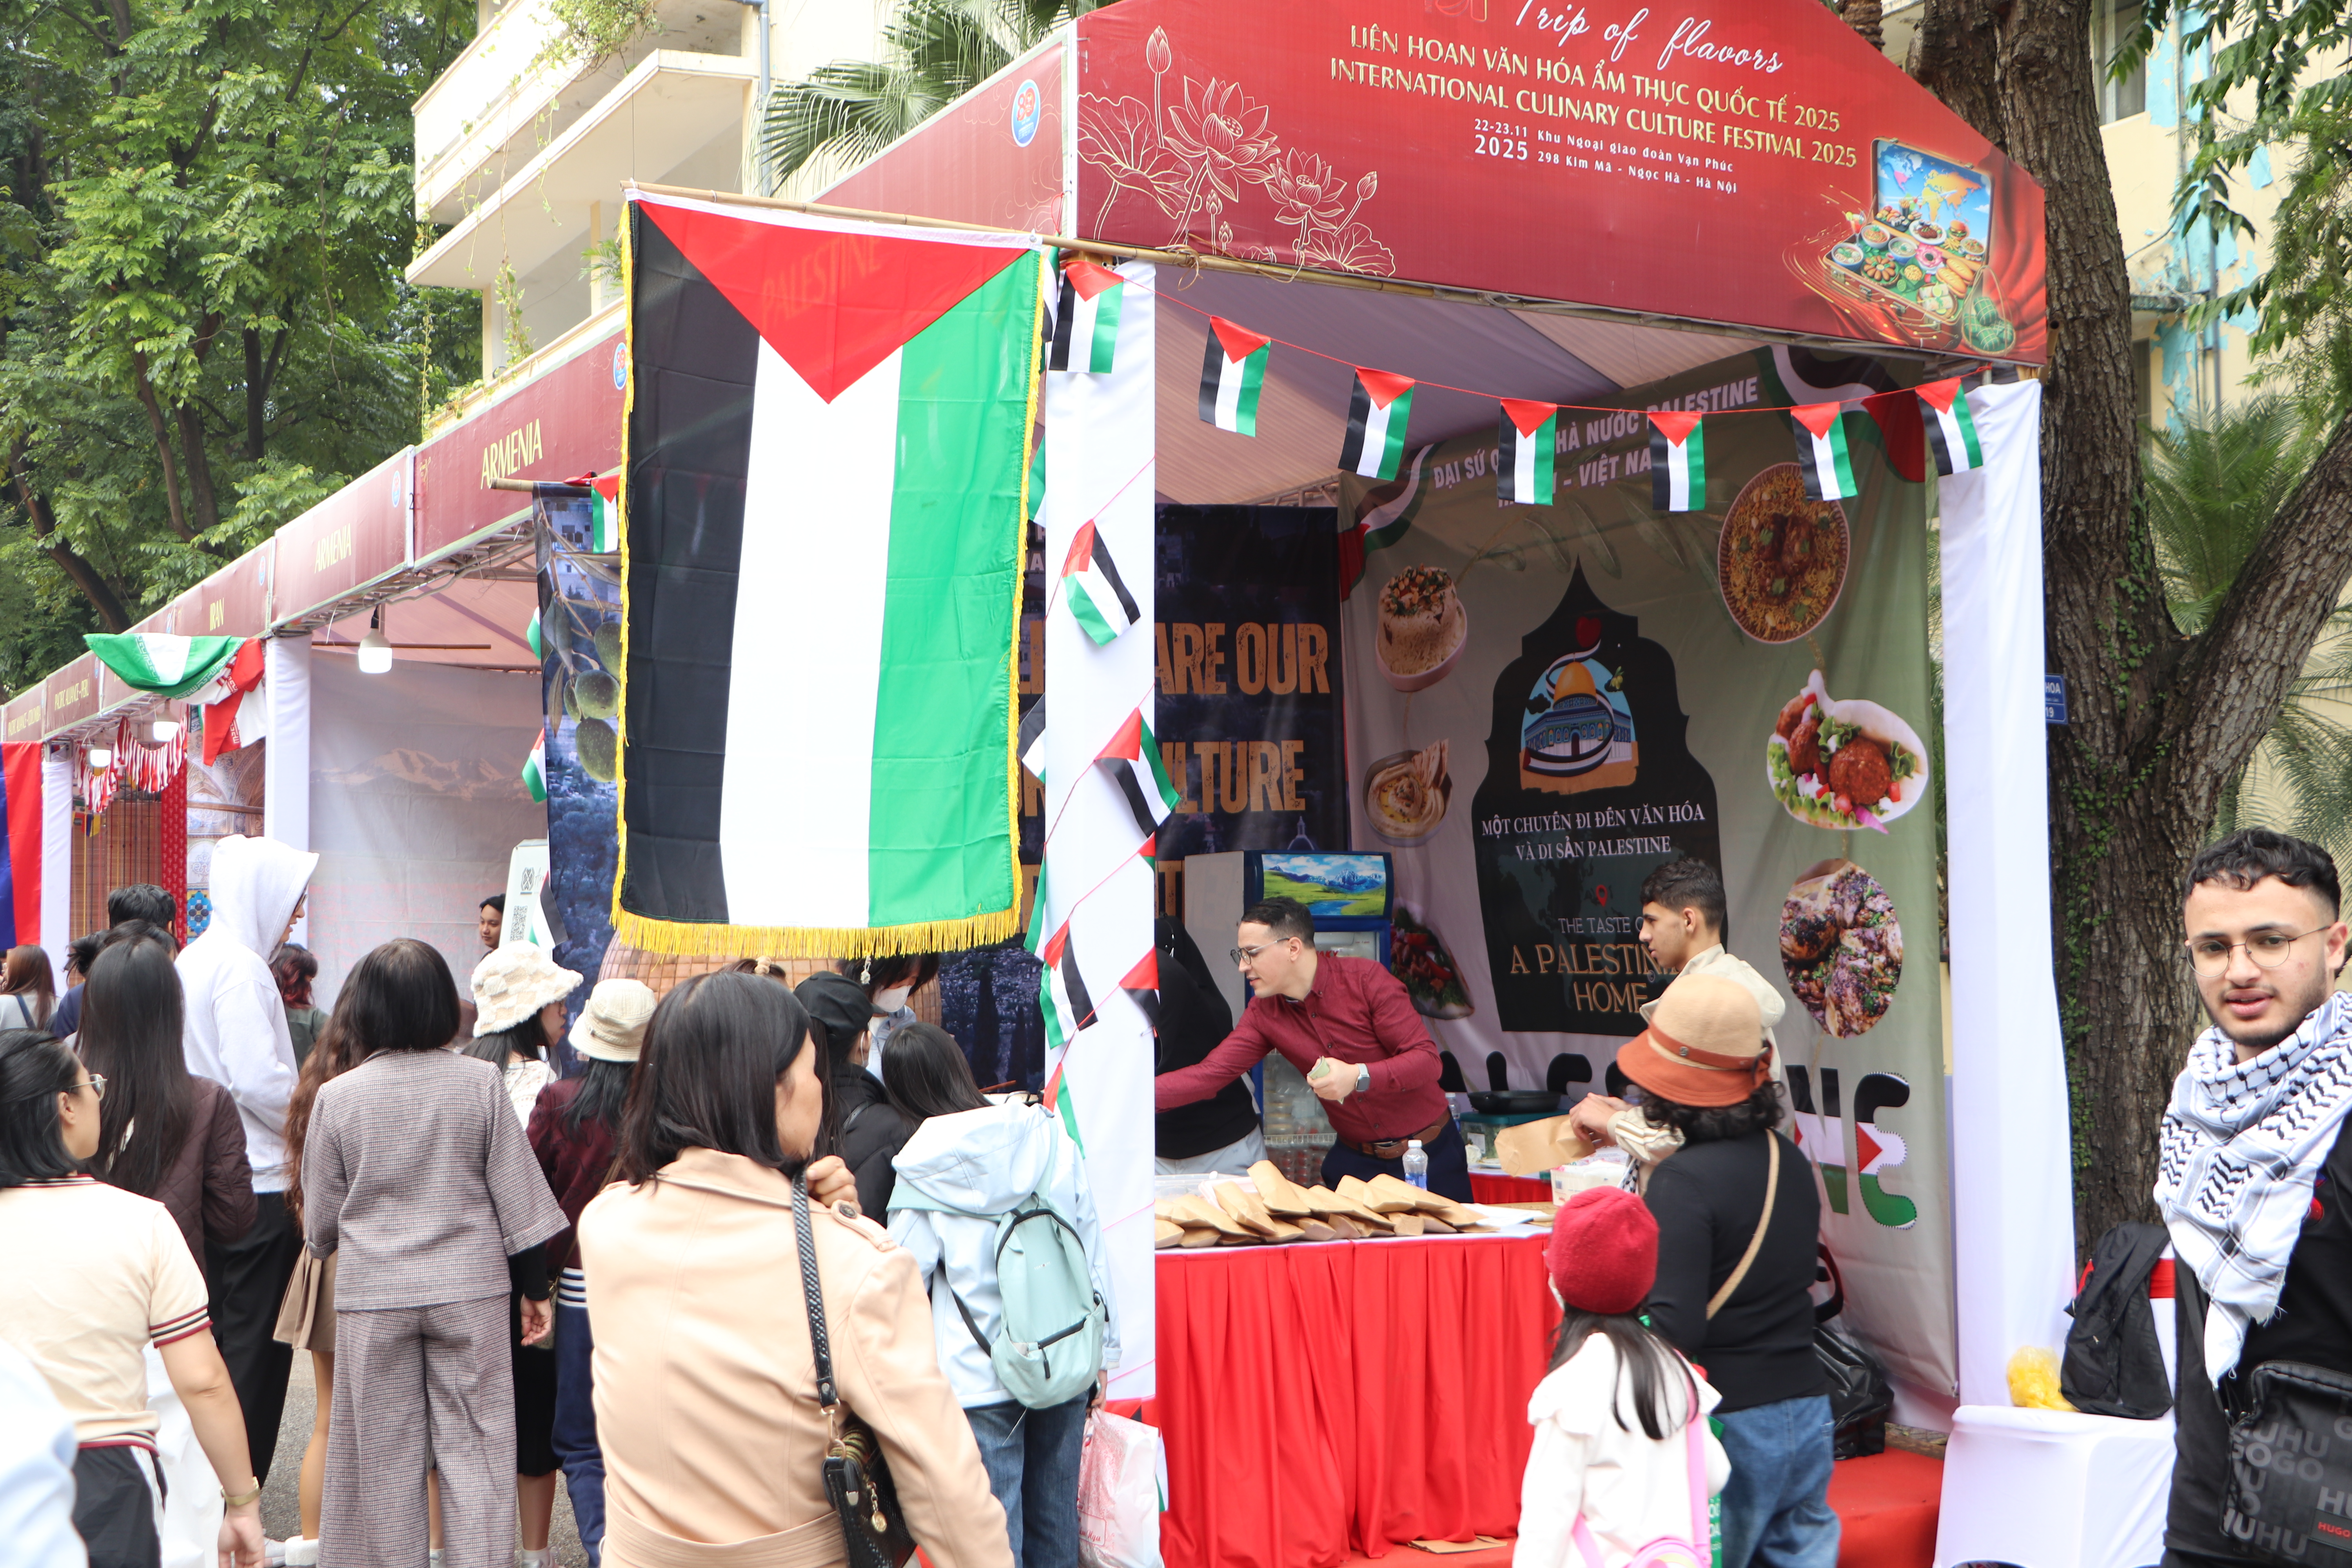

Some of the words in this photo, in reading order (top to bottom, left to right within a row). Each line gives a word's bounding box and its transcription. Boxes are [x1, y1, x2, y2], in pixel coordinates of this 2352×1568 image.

[1604, 7, 1649, 62] of
[1657, 17, 1783, 73] flavors
[1351, 23, 1398, 54] LIÊN
[1408, 35, 1475, 67] HOAN
[1483, 46, 1527, 77] VĂN
[1537, 57, 1586, 87] HÓA
[1592, 59, 1625, 94] ẨM
[1632, 75, 1689, 107] THỰC
[1697, 85, 1760, 118] QUỐC
[1766, 94, 1788, 123] TẾ
[1794, 105, 1840, 132] 2025
[1331, 57, 1508, 109] INTERNATIONAL
[1516, 89, 1619, 127] CULINARY
[1626, 108, 1716, 144] CULTURE
[1723, 125, 1806, 160] FESTIVAL
[1811, 141, 1857, 168] 2025
[1474, 118, 1528, 138] 22-23.11
[1474, 134, 1528, 161] 2025
[1538, 130, 1561, 143] Khu
[1568, 134, 1603, 151] Ngoại
[1610, 142, 1636, 155] giao
[1642, 147, 1672, 162] đoàn
[1678, 153, 1699, 167] Vạn
[1705, 158, 1733, 172] Phúc
[1538, 151, 1560, 164] 298
[1566, 156, 1588, 169] Kim
[1595, 160, 1612, 172] Mã
[1628, 165, 1659, 180] Ngọc
[1665, 171, 1680, 184] Hà
[1696, 176, 1711, 189] Hà
[1717, 181, 1737, 193] Nội
[481, 418, 543, 490] ARMENIA
[1434, 460, 1461, 489] ĐẠI
[1464, 448, 1485, 479] SỨ
[1555, 421, 1581, 454] HÀ
[1586, 407, 1639, 446] NƯỚC
[1579, 454, 1619, 487] VIỆT
[1625, 447, 1651, 475] NA
[314, 523, 352, 574] ARMENIA
[210, 597, 224, 631] IRAN
[1154, 622, 1226, 695] ARE
[1236, 622, 1330, 695] OUR
[1162, 740, 1305, 813] LTURE
[1482, 814, 1510, 838] MỘT
[1576, 812, 1590, 829] ĐI
[1595, 806, 1626, 828] ĐẾN
[1630, 803, 1664, 825] VĂN
[1669, 800, 1705, 822] HÓA
[1515, 841, 1536, 860] VÀ
[1539, 843, 1552, 859] DI
[1556, 836, 1584, 858] SẢN
[1588, 836, 1671, 856] PALESTINE
[1558, 918, 1584, 933] THE
[1587, 917, 1631, 933] TASTE
[1510, 945, 1530, 974] A
[1534, 944, 1679, 975] PALESTIN
[1573, 981, 1648, 1013] HOME
[2240, 1421, 2330, 1458] UHU
[2318, 1521, 2351, 1538] HUGO
